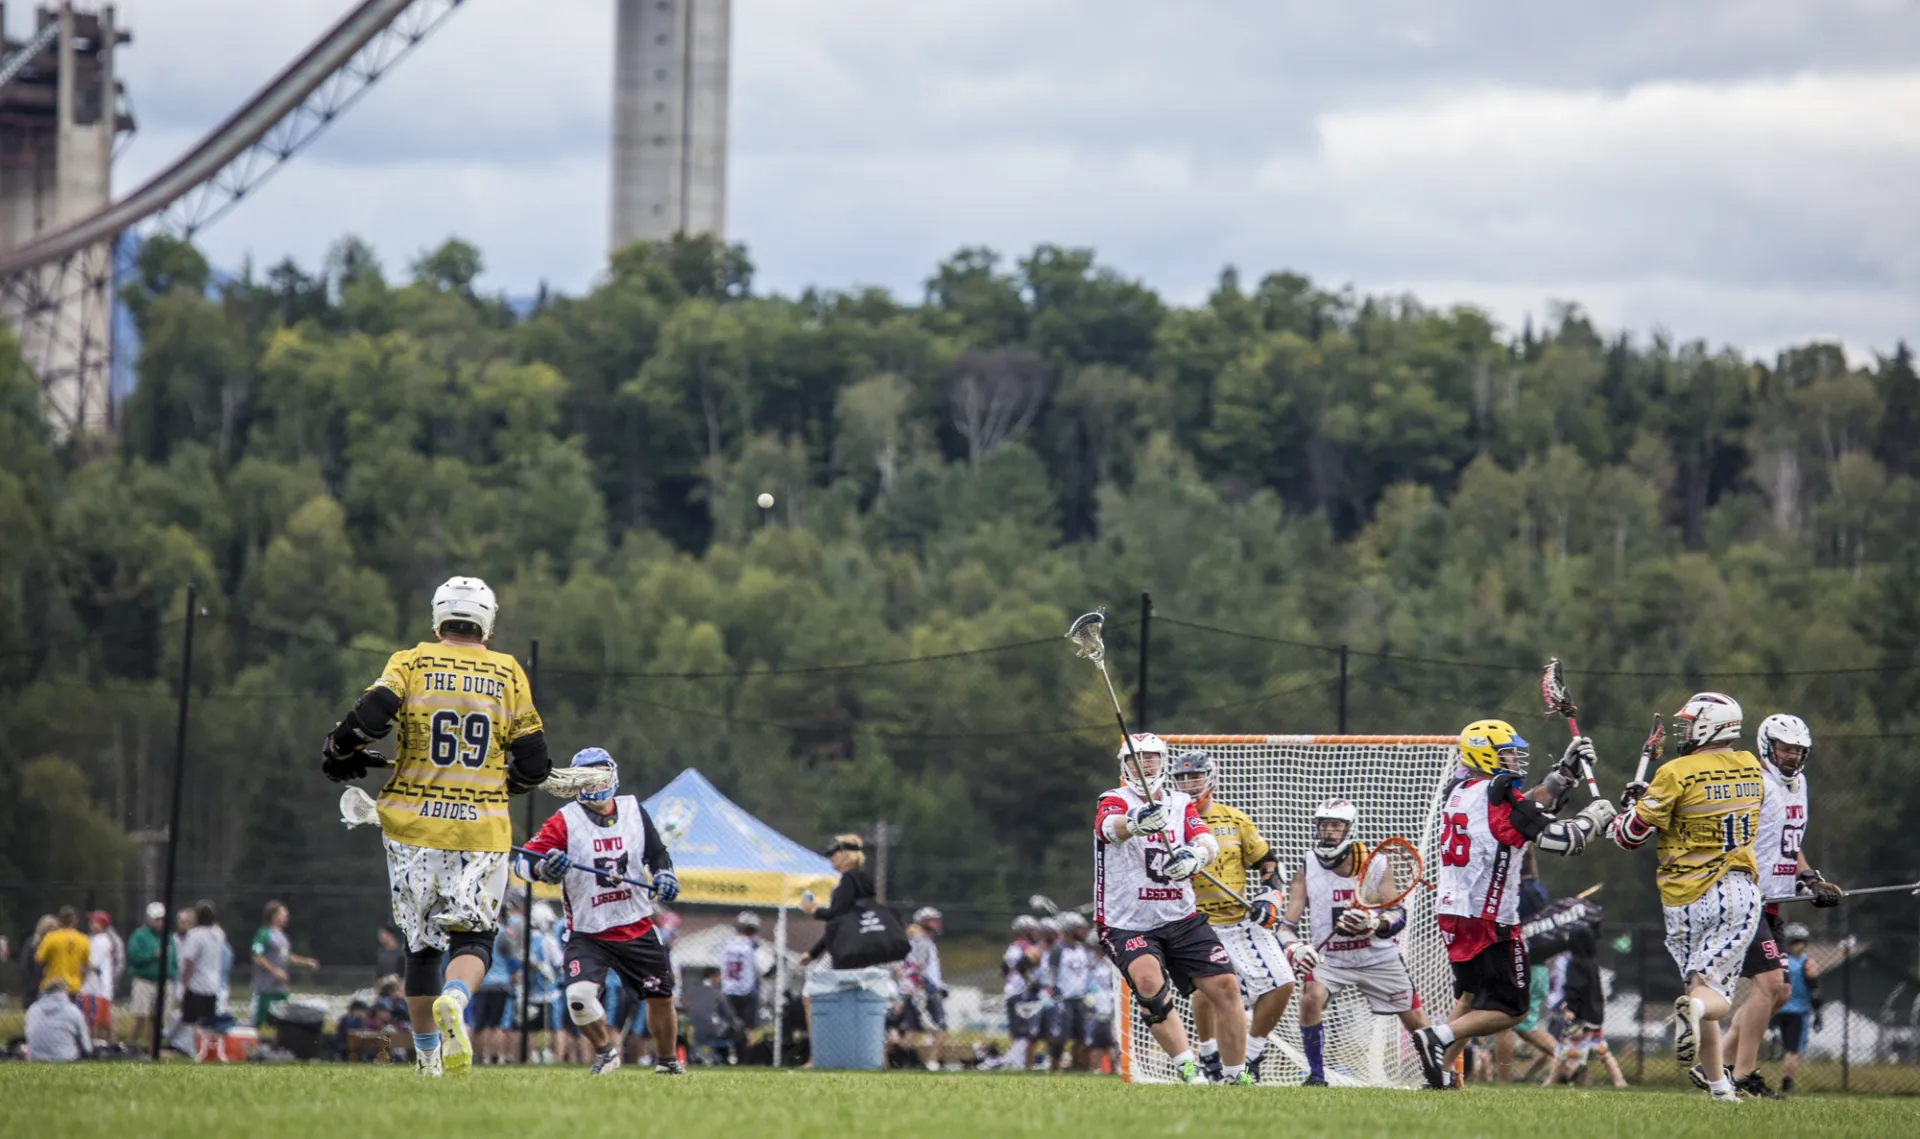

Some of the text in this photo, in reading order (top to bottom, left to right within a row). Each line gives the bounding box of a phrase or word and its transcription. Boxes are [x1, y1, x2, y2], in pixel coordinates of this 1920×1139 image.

[424, 672, 505, 699] THE DUDE
[430, 708, 492, 771] 69
[1704, 784, 1731, 800] THE
[419, 800, 478, 820] ABIDES
[1440, 812, 1470, 867] 26
[1723, 812, 1749, 852] 11
[1783, 828, 1803, 852] 50
[593, 837, 623, 852] OWU
[1486, 851, 1507, 914] BATTLING
[591, 889, 633, 907] LEGENDS
[1138, 888, 1184, 900] LEGENDS
[1333, 889, 1356, 902] OW
[569, 960, 580, 977] 3
